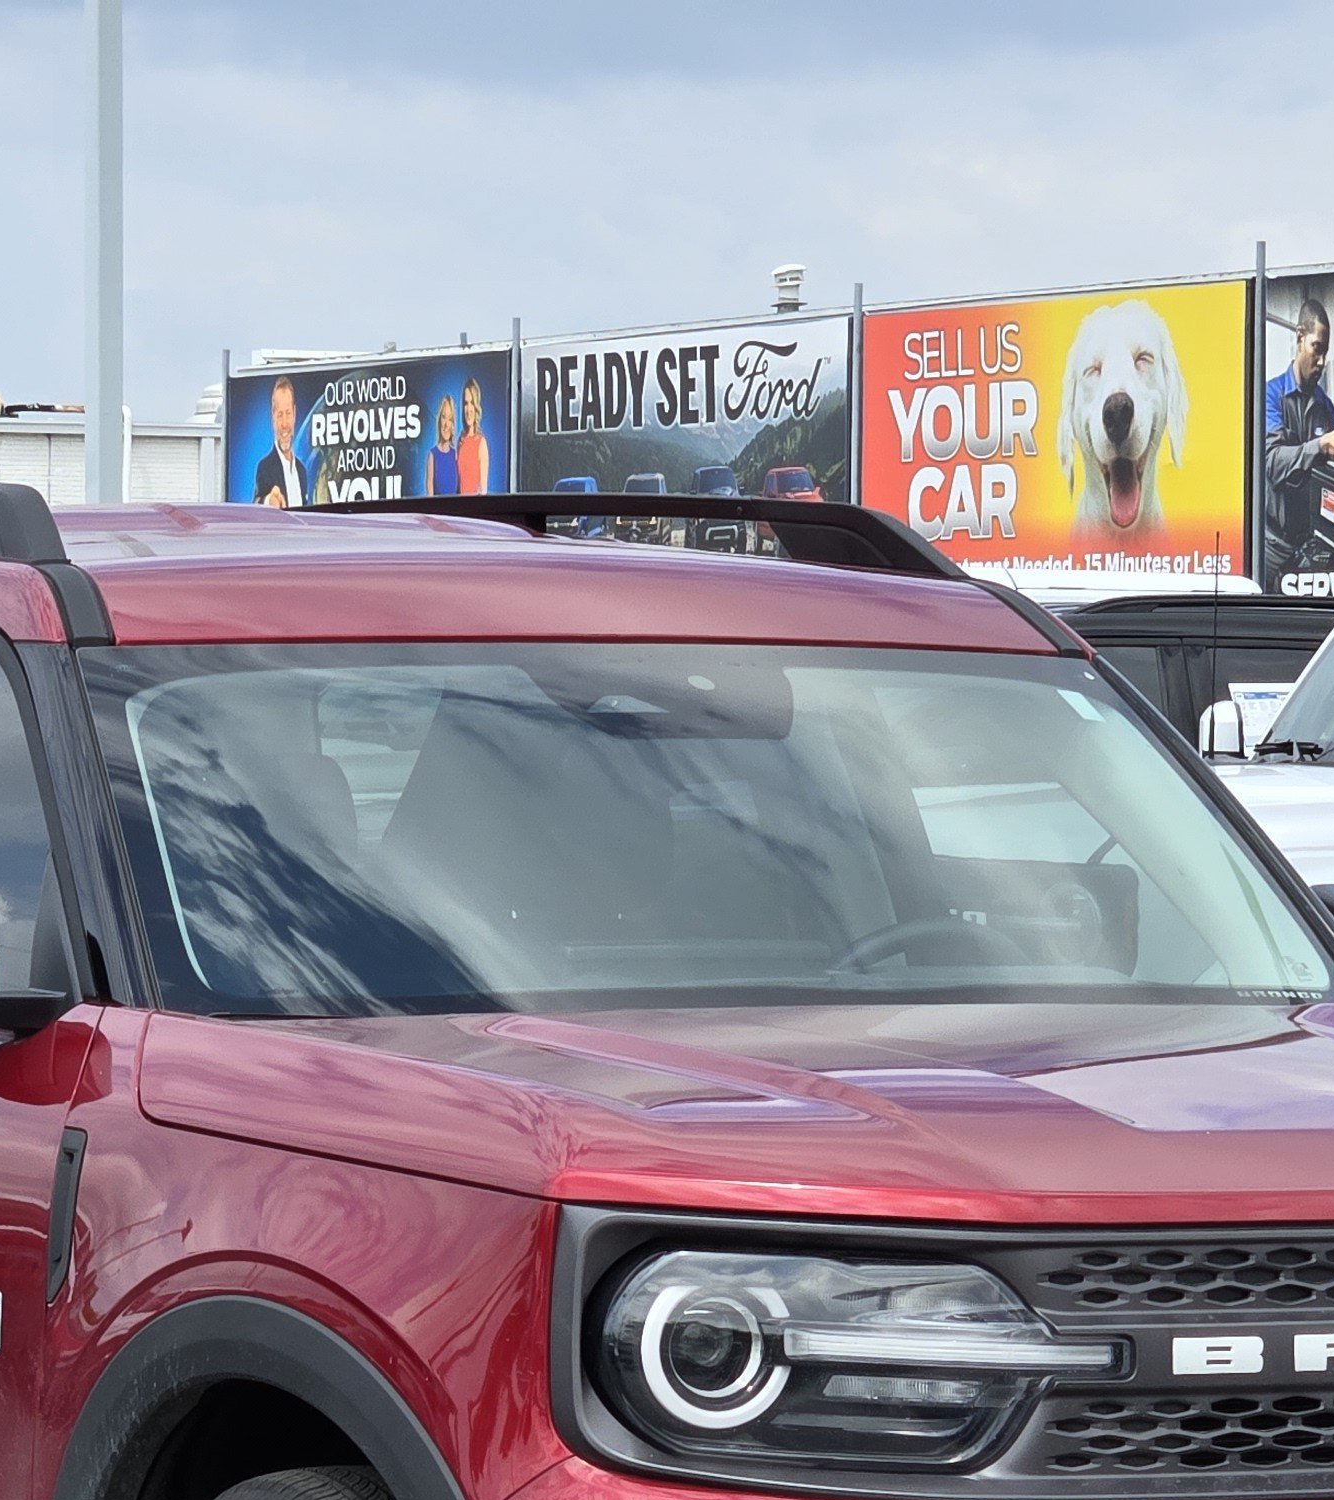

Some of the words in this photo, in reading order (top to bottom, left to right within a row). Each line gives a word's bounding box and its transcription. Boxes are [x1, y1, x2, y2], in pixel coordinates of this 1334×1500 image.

[904, 328, 975, 380] SELL
[980, 323, 1022, 375] US
[324, 381, 355, 407] OUR
[356, 375, 407, 403] WORLD
[536, 349, 649, 434] READY
[655, 344, 720, 427] SET
[723, 340, 823, 421] Ford
[311, 404, 422, 447] REVOLVES
[887, 380, 1038, 462] YOUR
[336, 445, 396, 473] AROUND
[908, 463, 1017, 543] CAR
[1084, 553, 1102, 571] 15
[1105, 551, 1170, 573] Minutes
[1173, 554, 1191, 574] or
[1193, 550, 1232, 574] Less
